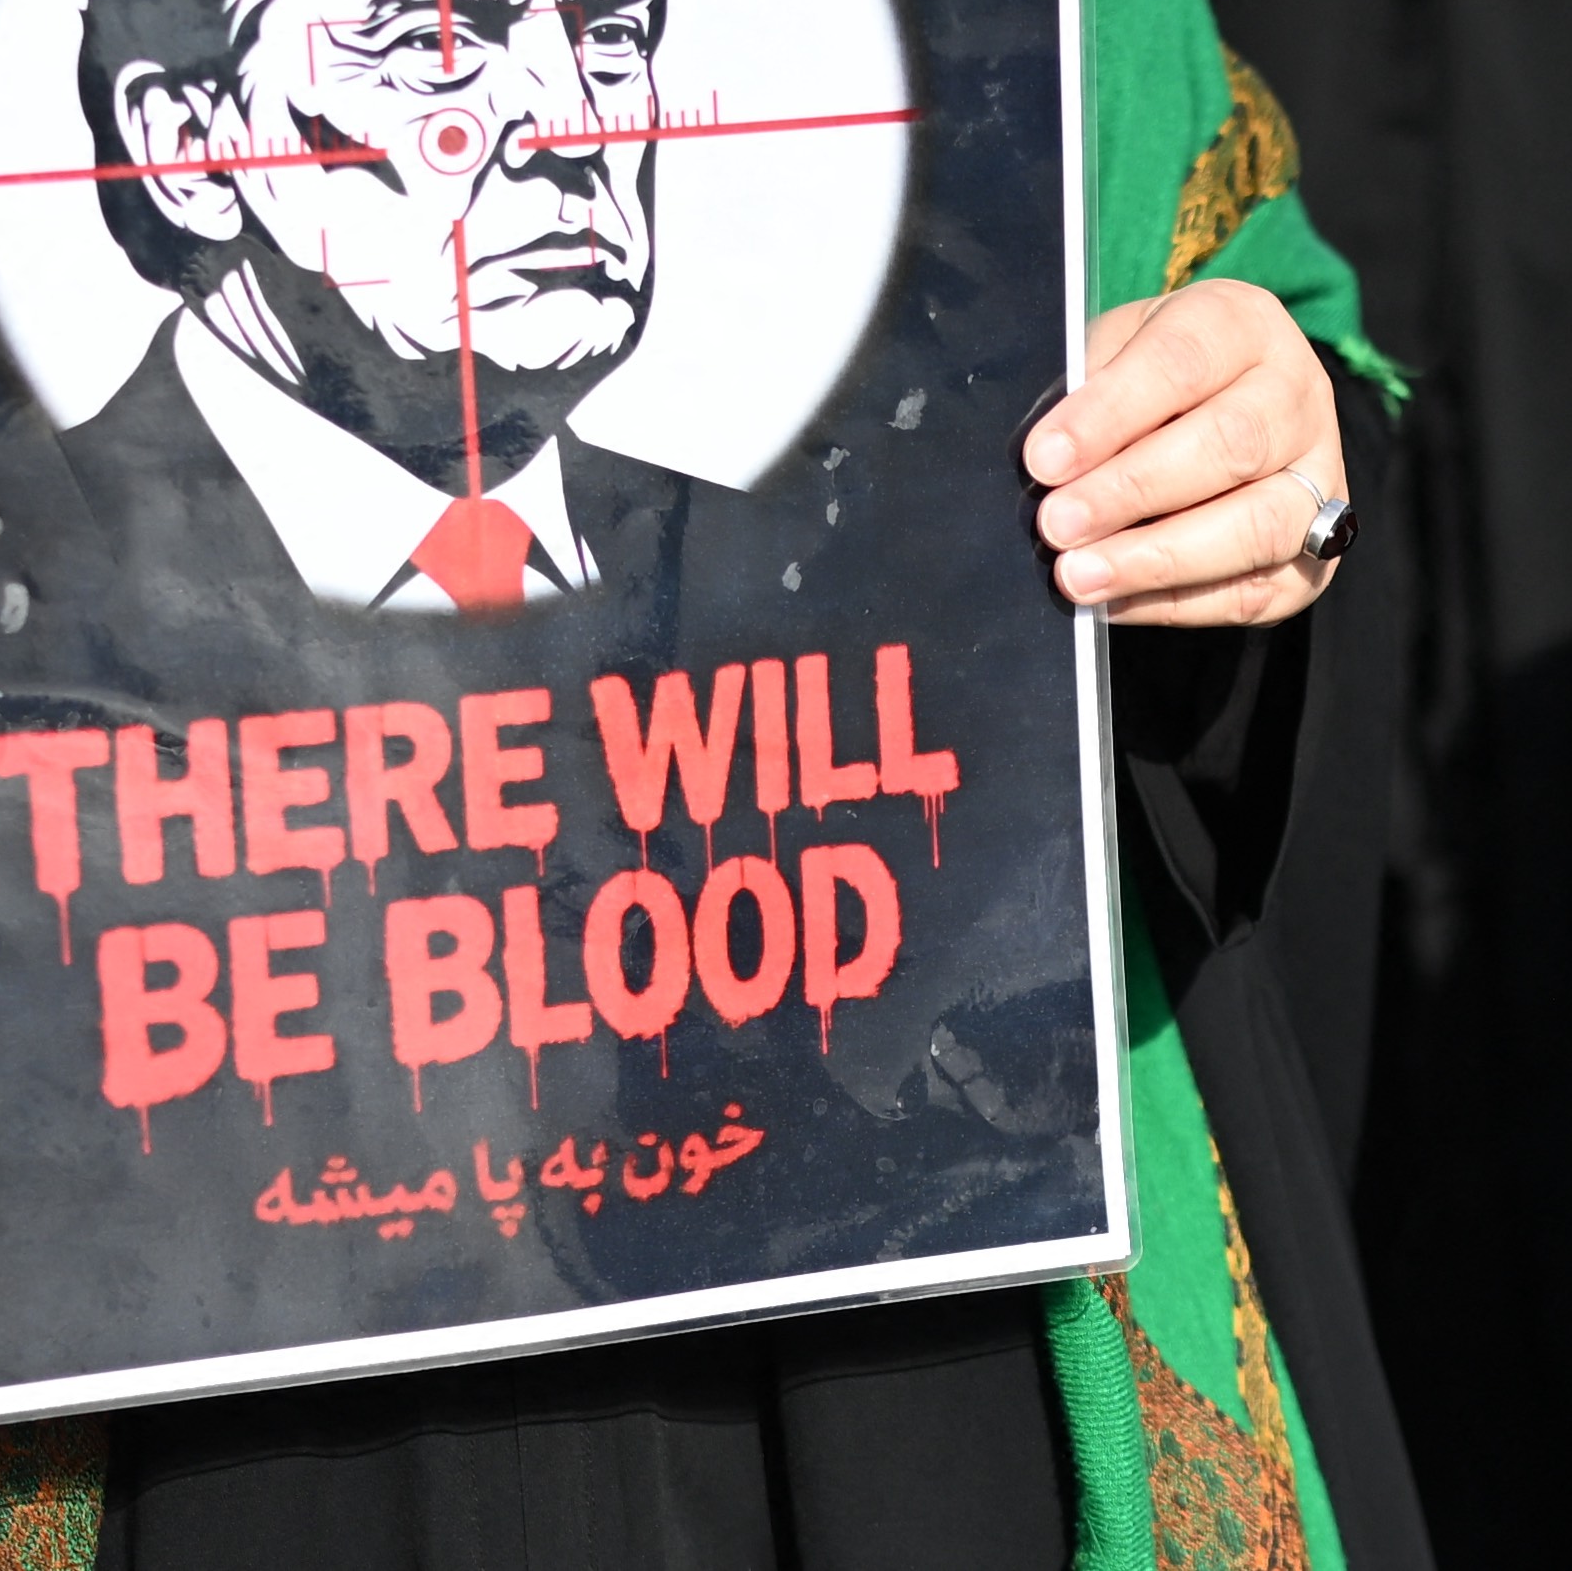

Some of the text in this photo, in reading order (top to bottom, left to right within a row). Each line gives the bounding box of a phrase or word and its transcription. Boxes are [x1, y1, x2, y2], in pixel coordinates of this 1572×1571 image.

[589, 642, 961, 869] WILL
[95, 843, 902, 1154] BE BLOOD
[254, 1101, 766, 1241] خون به پا میشه
